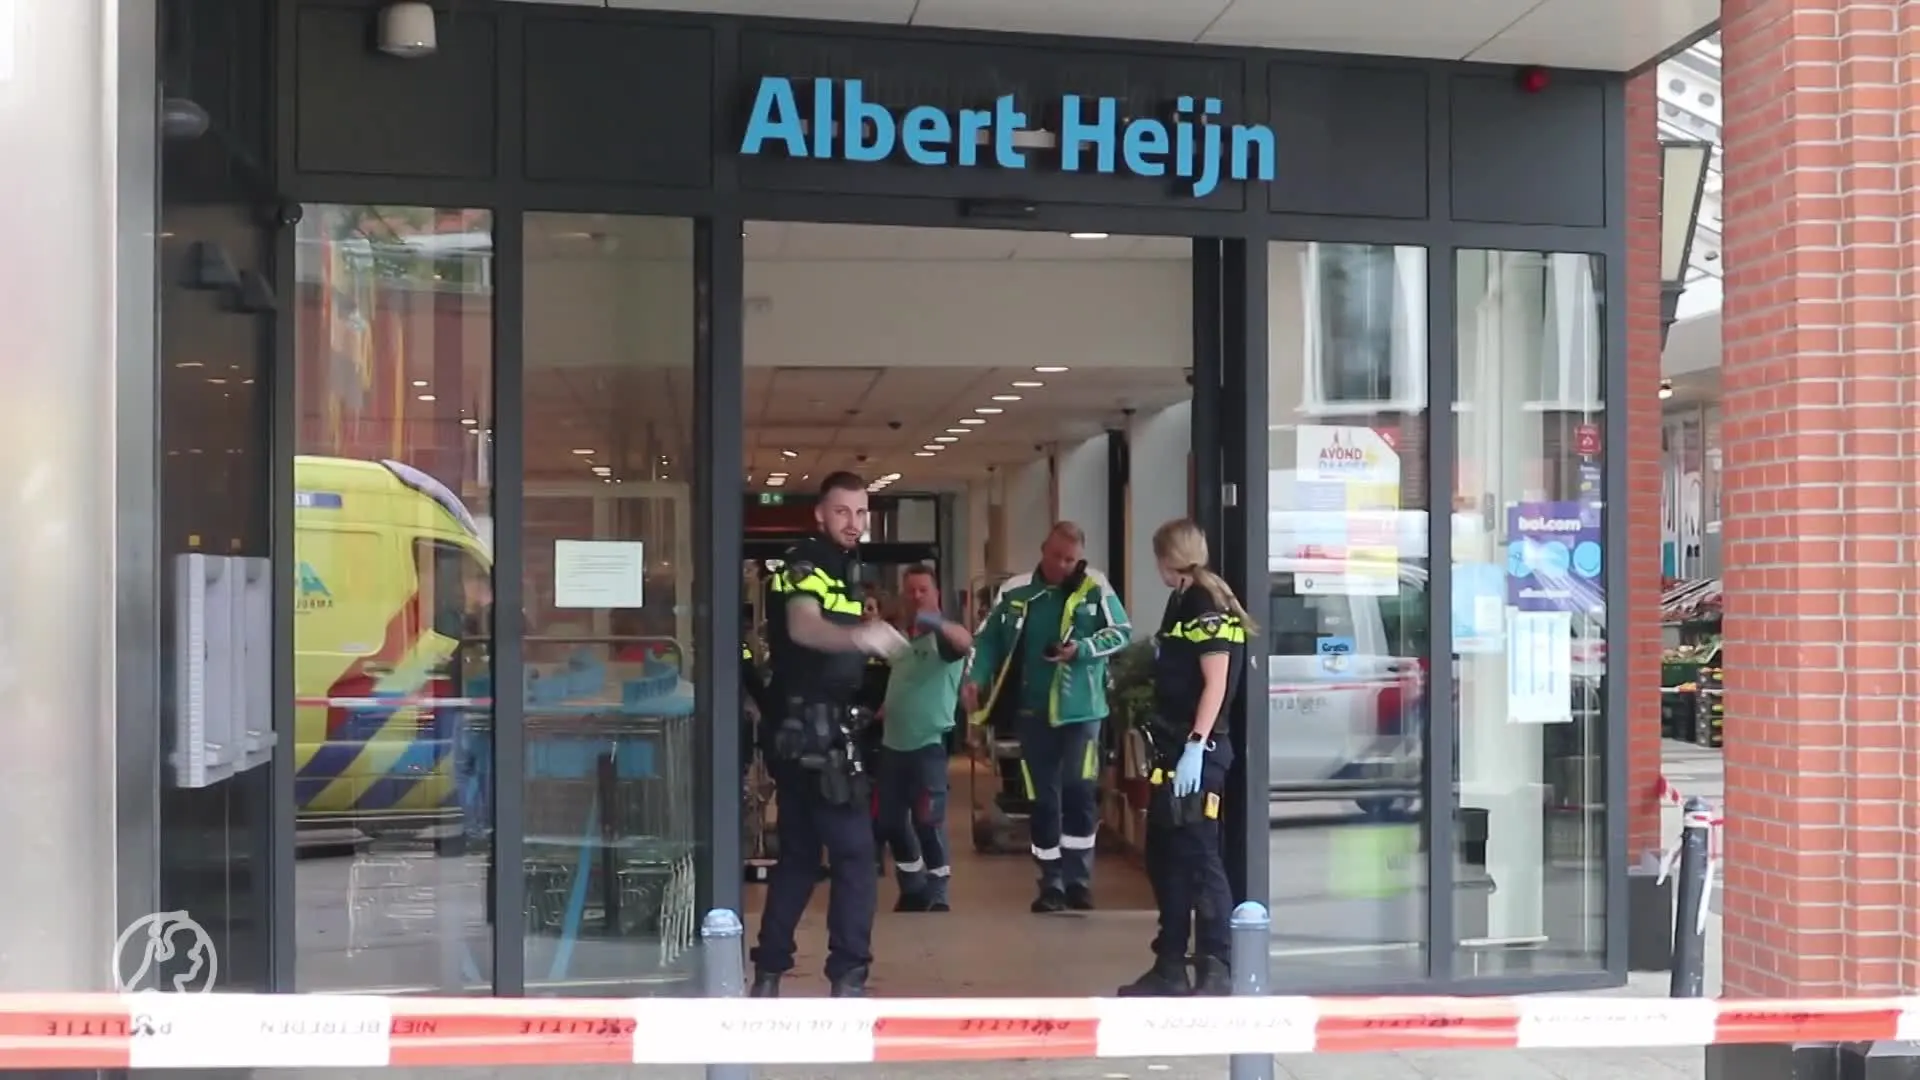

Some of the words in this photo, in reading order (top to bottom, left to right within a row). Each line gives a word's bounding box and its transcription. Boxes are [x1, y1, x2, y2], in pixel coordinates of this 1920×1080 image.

[740, 76, 1027, 168] Albert
[1061, 94, 1275, 198] Heijn
[1320, 447, 1363, 460] AVOND
[389, 1019, 438, 1034] NIET
